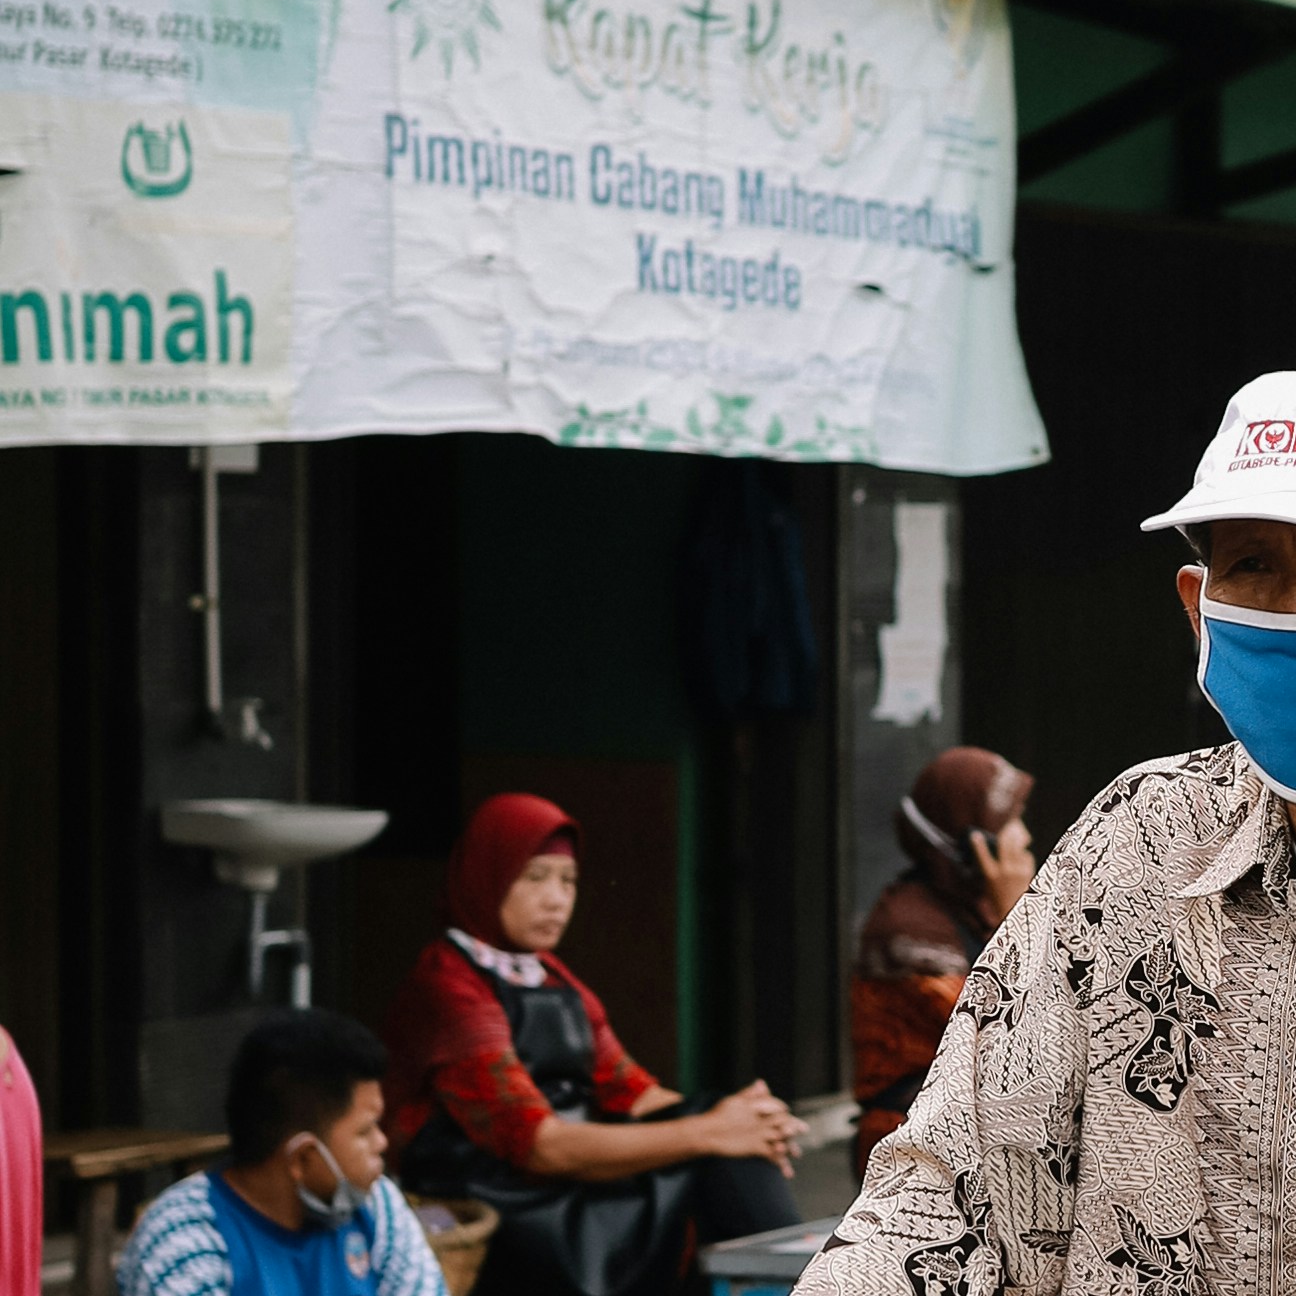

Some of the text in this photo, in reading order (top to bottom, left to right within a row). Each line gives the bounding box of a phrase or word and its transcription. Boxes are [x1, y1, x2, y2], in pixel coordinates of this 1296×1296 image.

[384, 113, 576, 201] Pimpinan
[589, 143, 726, 231] Cabang
[635, 232, 803, 312] Kotagede
